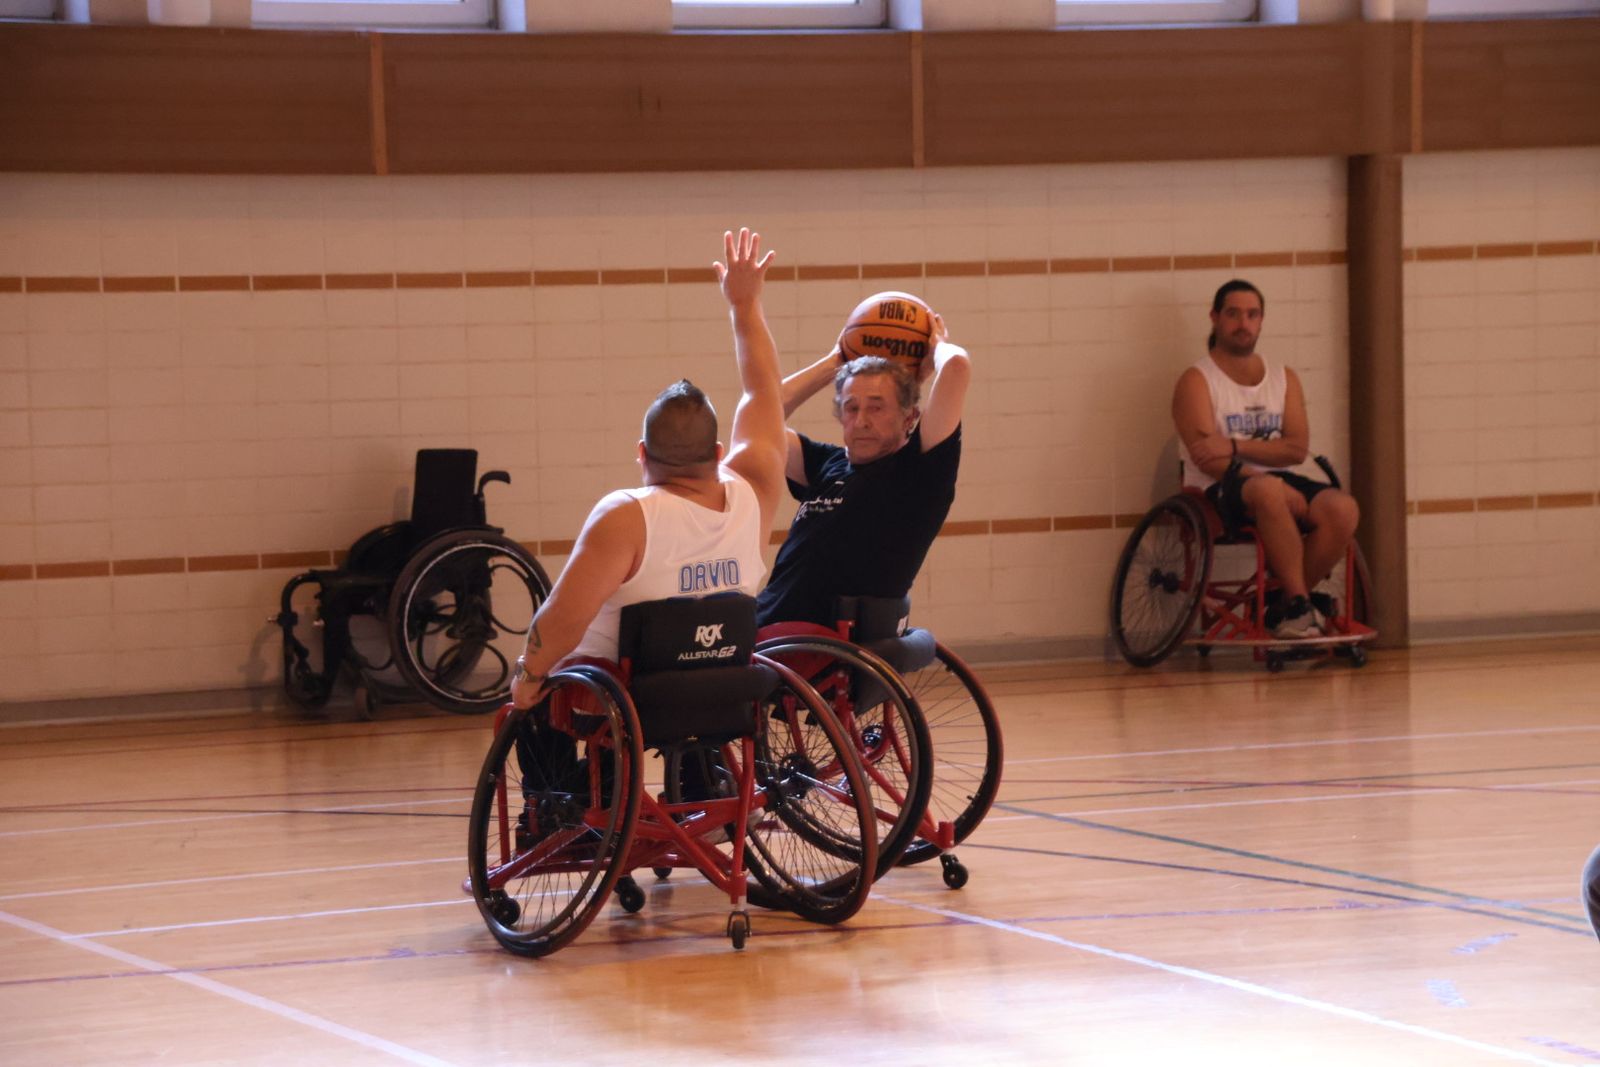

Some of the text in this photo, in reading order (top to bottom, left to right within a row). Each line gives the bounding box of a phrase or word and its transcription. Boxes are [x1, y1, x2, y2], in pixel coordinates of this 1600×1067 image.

[880, 301, 905, 320] NBA
[862, 335, 927, 358] Wilson
[678, 558, 741, 593] DAVID
